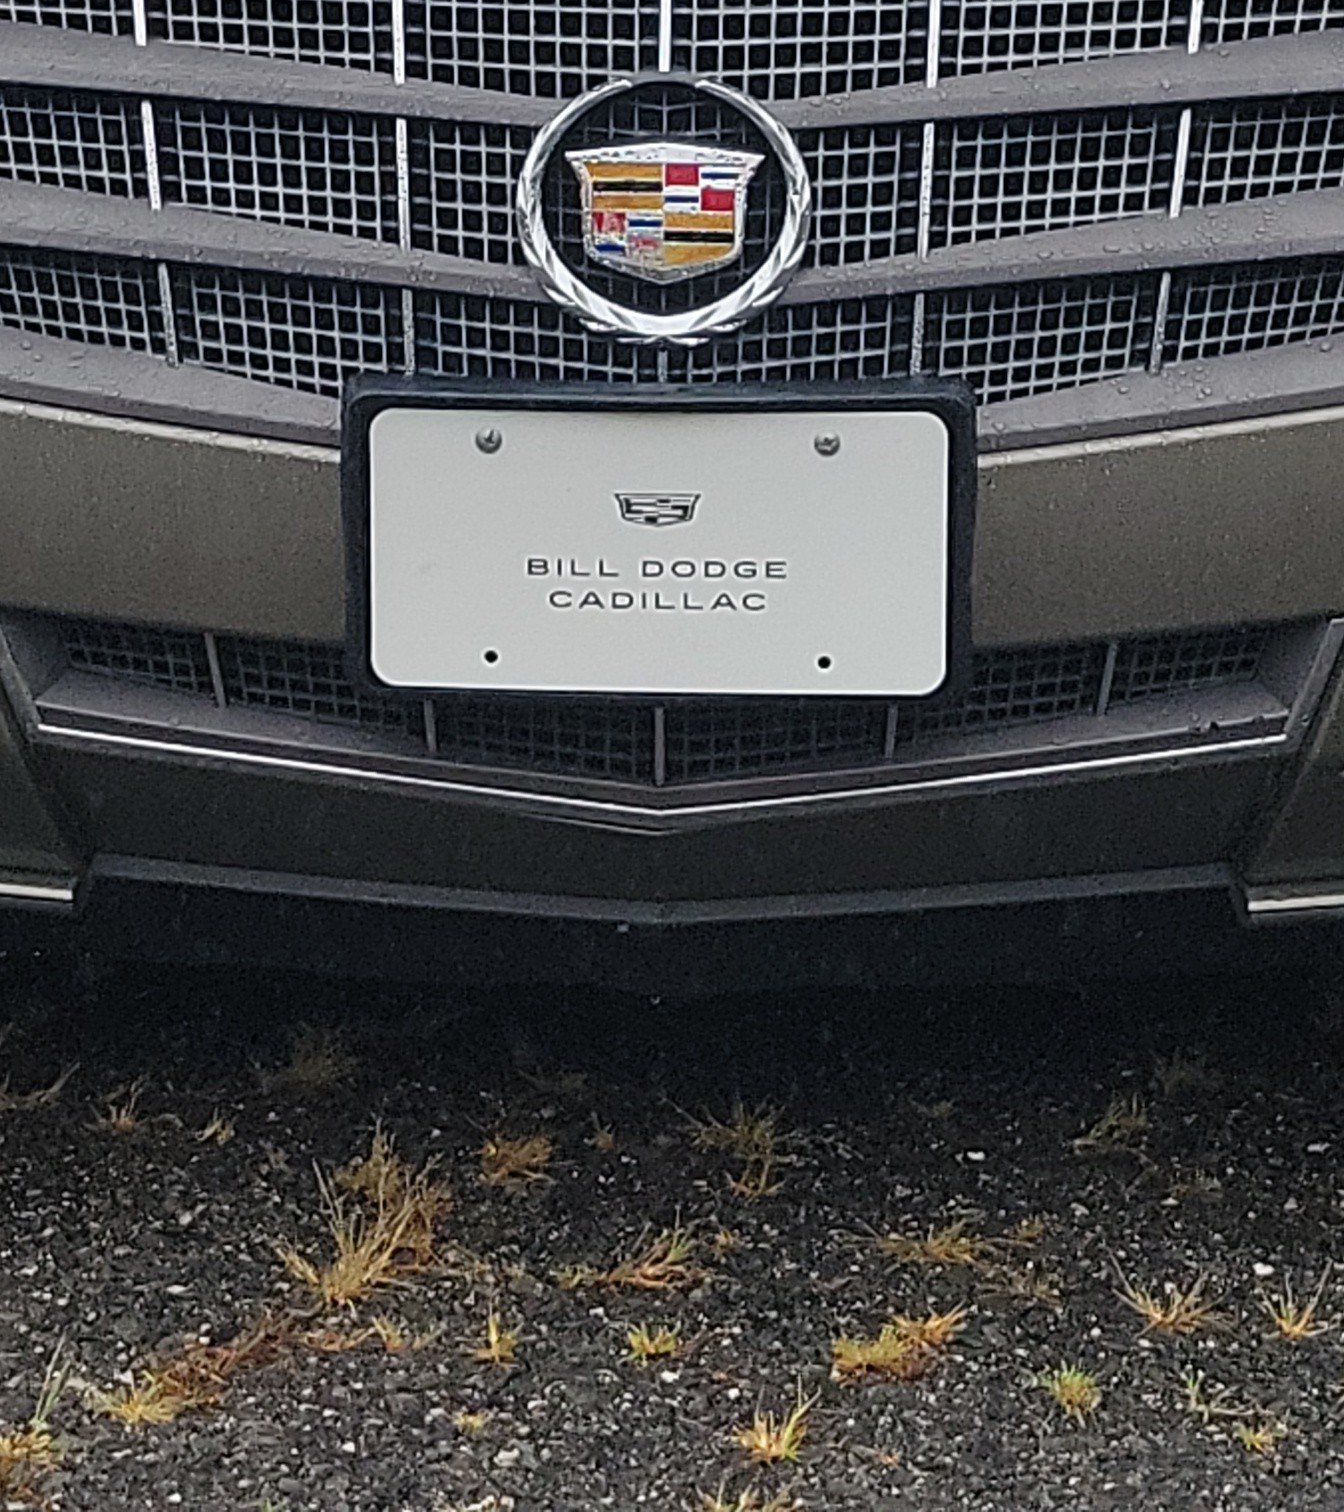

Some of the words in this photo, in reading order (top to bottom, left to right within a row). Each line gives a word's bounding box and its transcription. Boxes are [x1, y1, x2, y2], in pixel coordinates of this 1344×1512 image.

[527, 558, 619, 577] BILL
[642, 561, 787, 579] DODGE
[549, 591, 766, 611] CADILLAC
